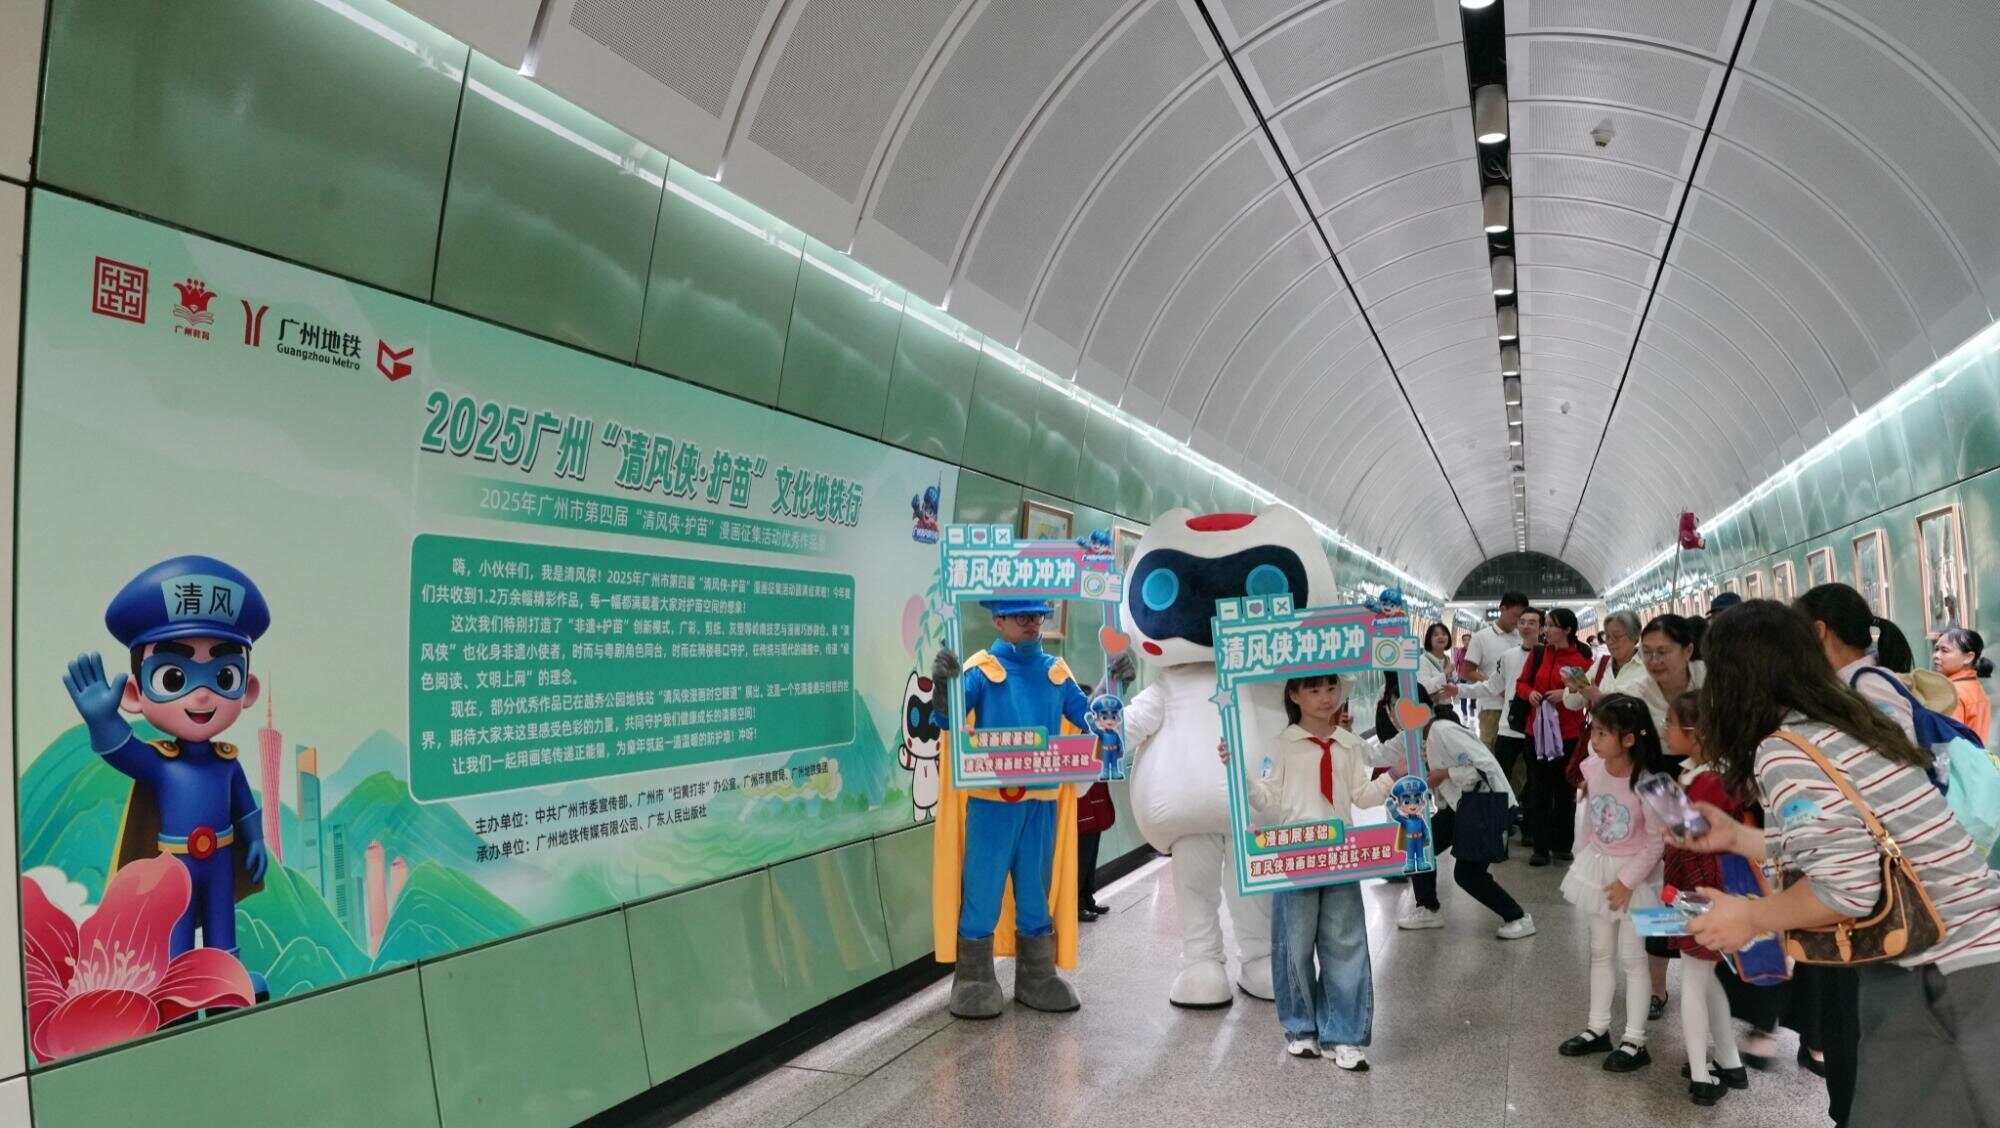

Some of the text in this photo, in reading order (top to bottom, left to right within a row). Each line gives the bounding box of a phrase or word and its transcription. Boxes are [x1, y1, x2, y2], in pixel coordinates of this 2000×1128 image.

[277, 318, 362, 359] 广州地铁
[276, 342, 361, 370] Guangzhou Metro
[946, 557, 1076, 588] 清风侠冲冲冲
[173, 583, 235, 617] 清风
[1221, 624, 1365, 671] 清风侠冲冲冲
[1263, 824, 1329, 848] 漫画展基础
